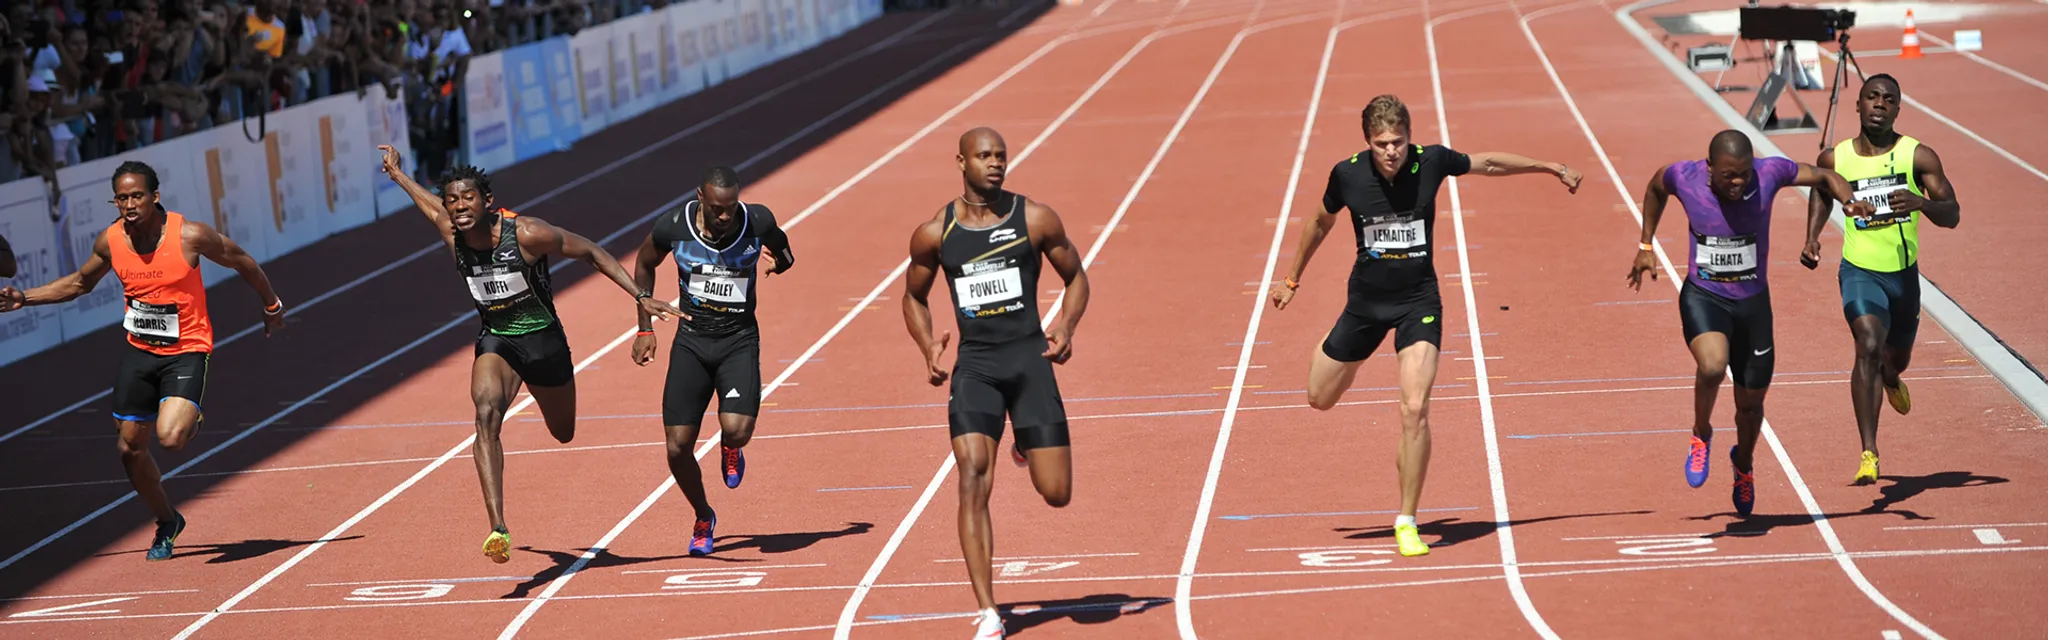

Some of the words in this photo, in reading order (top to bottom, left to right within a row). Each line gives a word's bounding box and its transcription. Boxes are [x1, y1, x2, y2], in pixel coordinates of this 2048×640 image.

[1862, 193, 1890, 207] ARN
[1374, 229, 1416, 242] LEMAITRE
[120, 269, 163, 280] Ultimate
[483, 281, 508, 294] KOFFI
[704, 280, 733, 296] BAILEY
[969, 278, 1008, 299] POWELL
[133, 317, 167, 331] MORRIS
